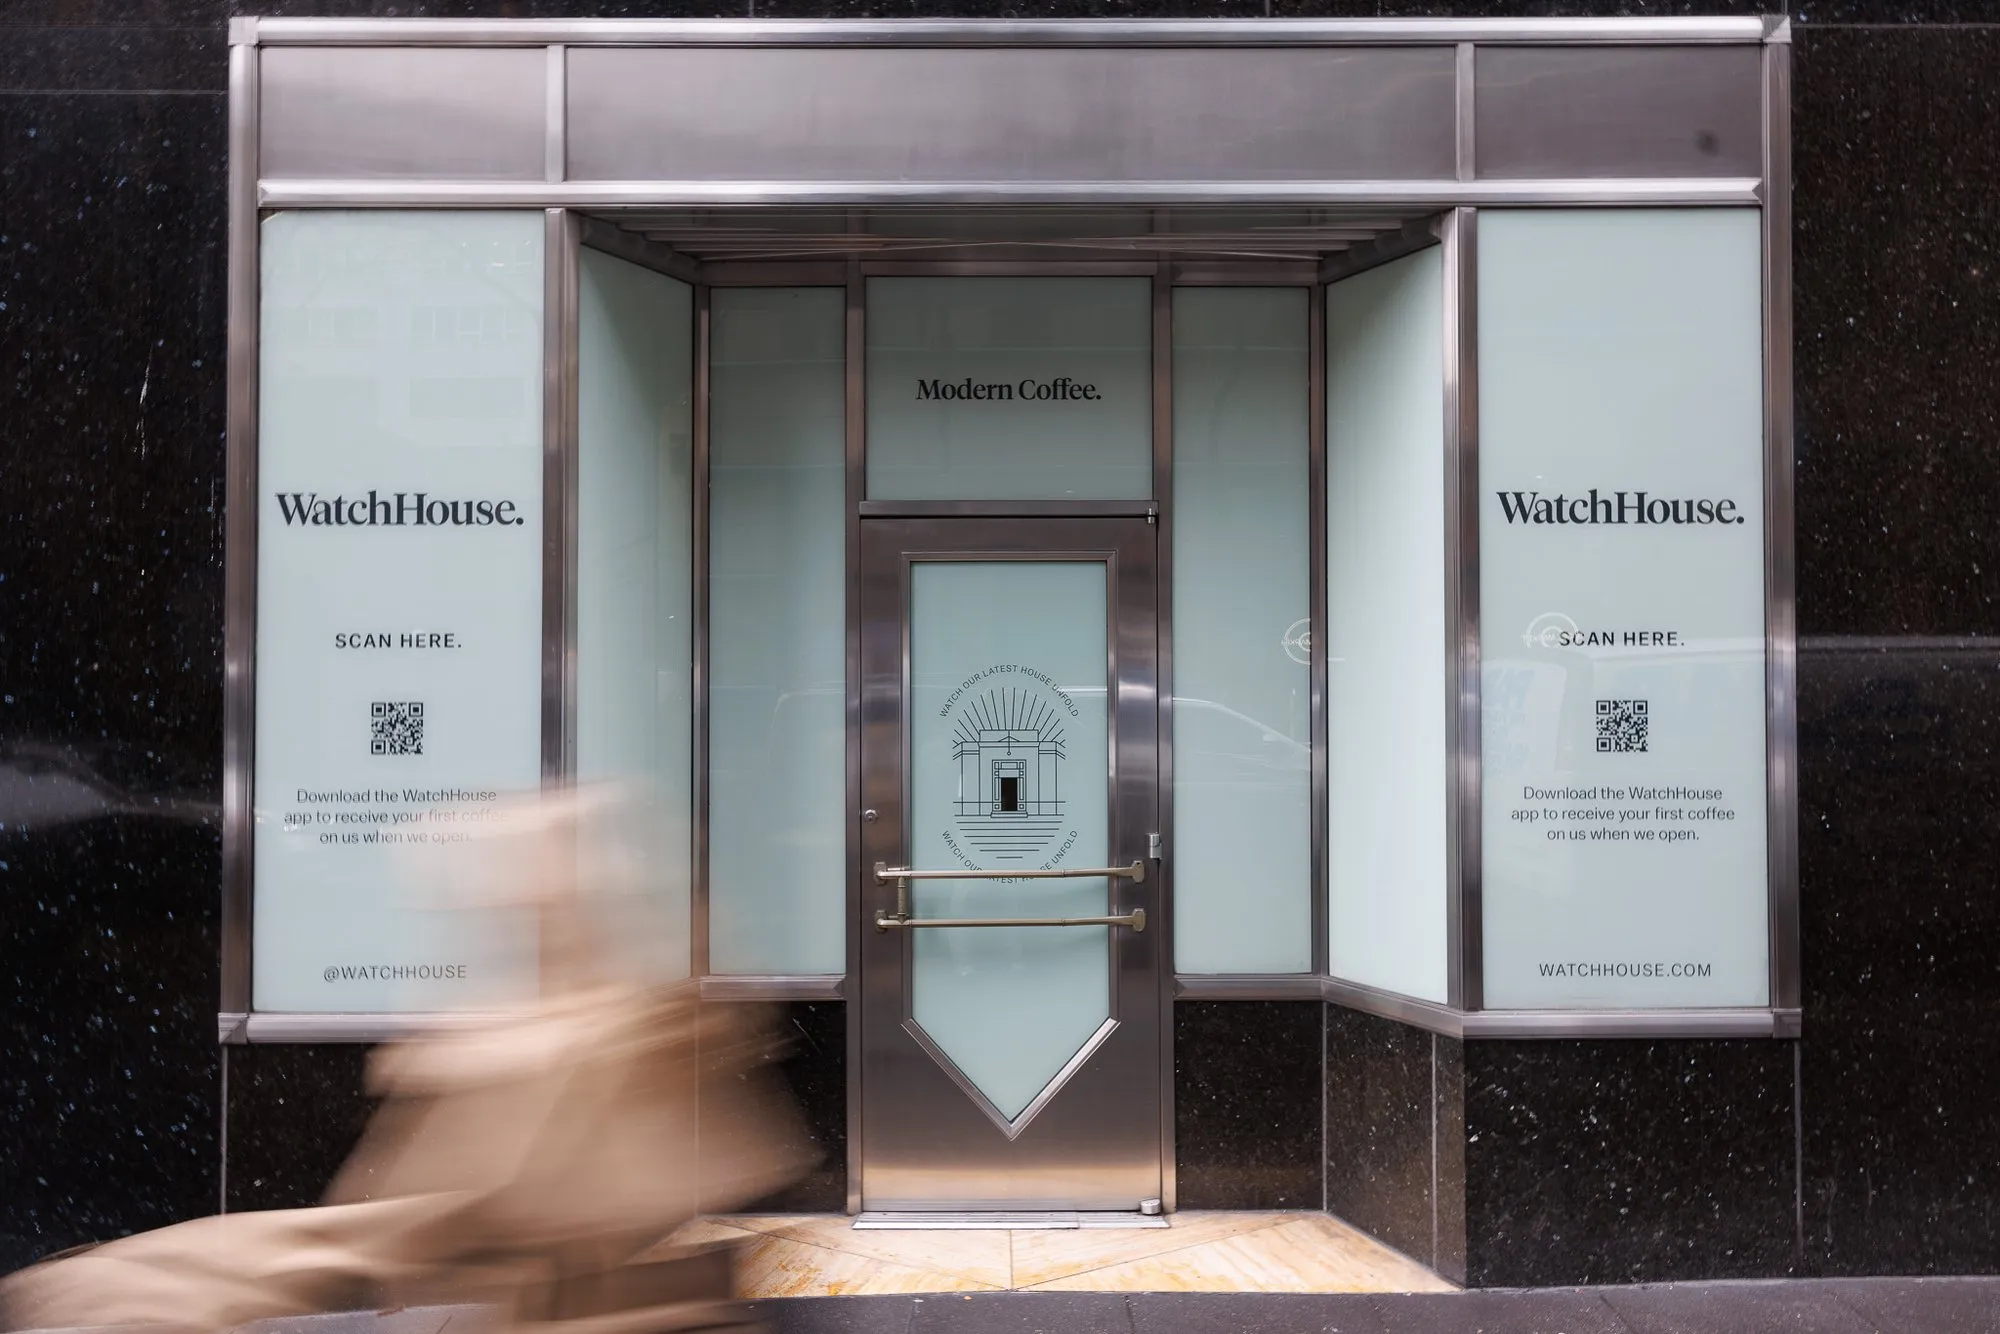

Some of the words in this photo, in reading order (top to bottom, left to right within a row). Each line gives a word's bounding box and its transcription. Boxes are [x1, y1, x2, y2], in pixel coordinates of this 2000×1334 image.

[916, 378, 1013, 400] Modern
[1018, 377, 1102, 400] Coffee.
[276, 490, 525, 527] WatchHouse.
[1496, 488, 1745, 525] WatchHouse.
[335, 632, 391, 649] SCAN
[400, 632, 462, 649] HERE.
[1559, 631, 1615, 647] SCAN
[1623, 631, 1685, 647] HERE.
[939, 687, 964, 718] WATCH
[962, 673, 981, 690] OUR
[982, 664, 1018, 678] LATEST
[1020, 665, 1052, 686] HOUSE
[1051, 683, 1079, 718] UNFOLD
[296, 788, 370, 803] Download
[374, 789, 399, 803] the
[402, 788, 497, 803] WatchHouse
[1523, 786, 1597, 801] Download
[1600, 786, 1625, 800] the
[1628, 786, 1723, 801] WatchHouse
[284, 811, 312, 825] app
[316, 810, 331, 823] to
[335, 810, 388, 823] receive
[392, 812, 424, 825] your
[428, 808, 456, 822] first
[1511, 809, 1539, 823] app
[1543, 808, 1558, 820] to
[1561, 807, 1615, 820] receive
[1619, 810, 1651, 823] your
[1655, 806, 1685, 820] first
[1687, 806, 1736, 820] coffee
[319, 832, 338, 844] on
[341, 832, 359, 844] us
[363, 829, 403, 844] when
[407, 832, 428, 843] we
[432, 832, 473, 846] open.
[1547, 829, 1566, 841] on
[1569, 829, 1587, 841] us
[1590, 826, 1630, 841] when
[1634, 829, 1655, 841] we
[1658, 829, 1700, 844] open.
[942, 830, 965, 861] WATCH
[1051, 830, 1078, 864] UNFOLD
[323, 964, 468, 983] @WATCHHOUSE
[1539, 961, 1712, 978] WATCHHOUSE.COM
